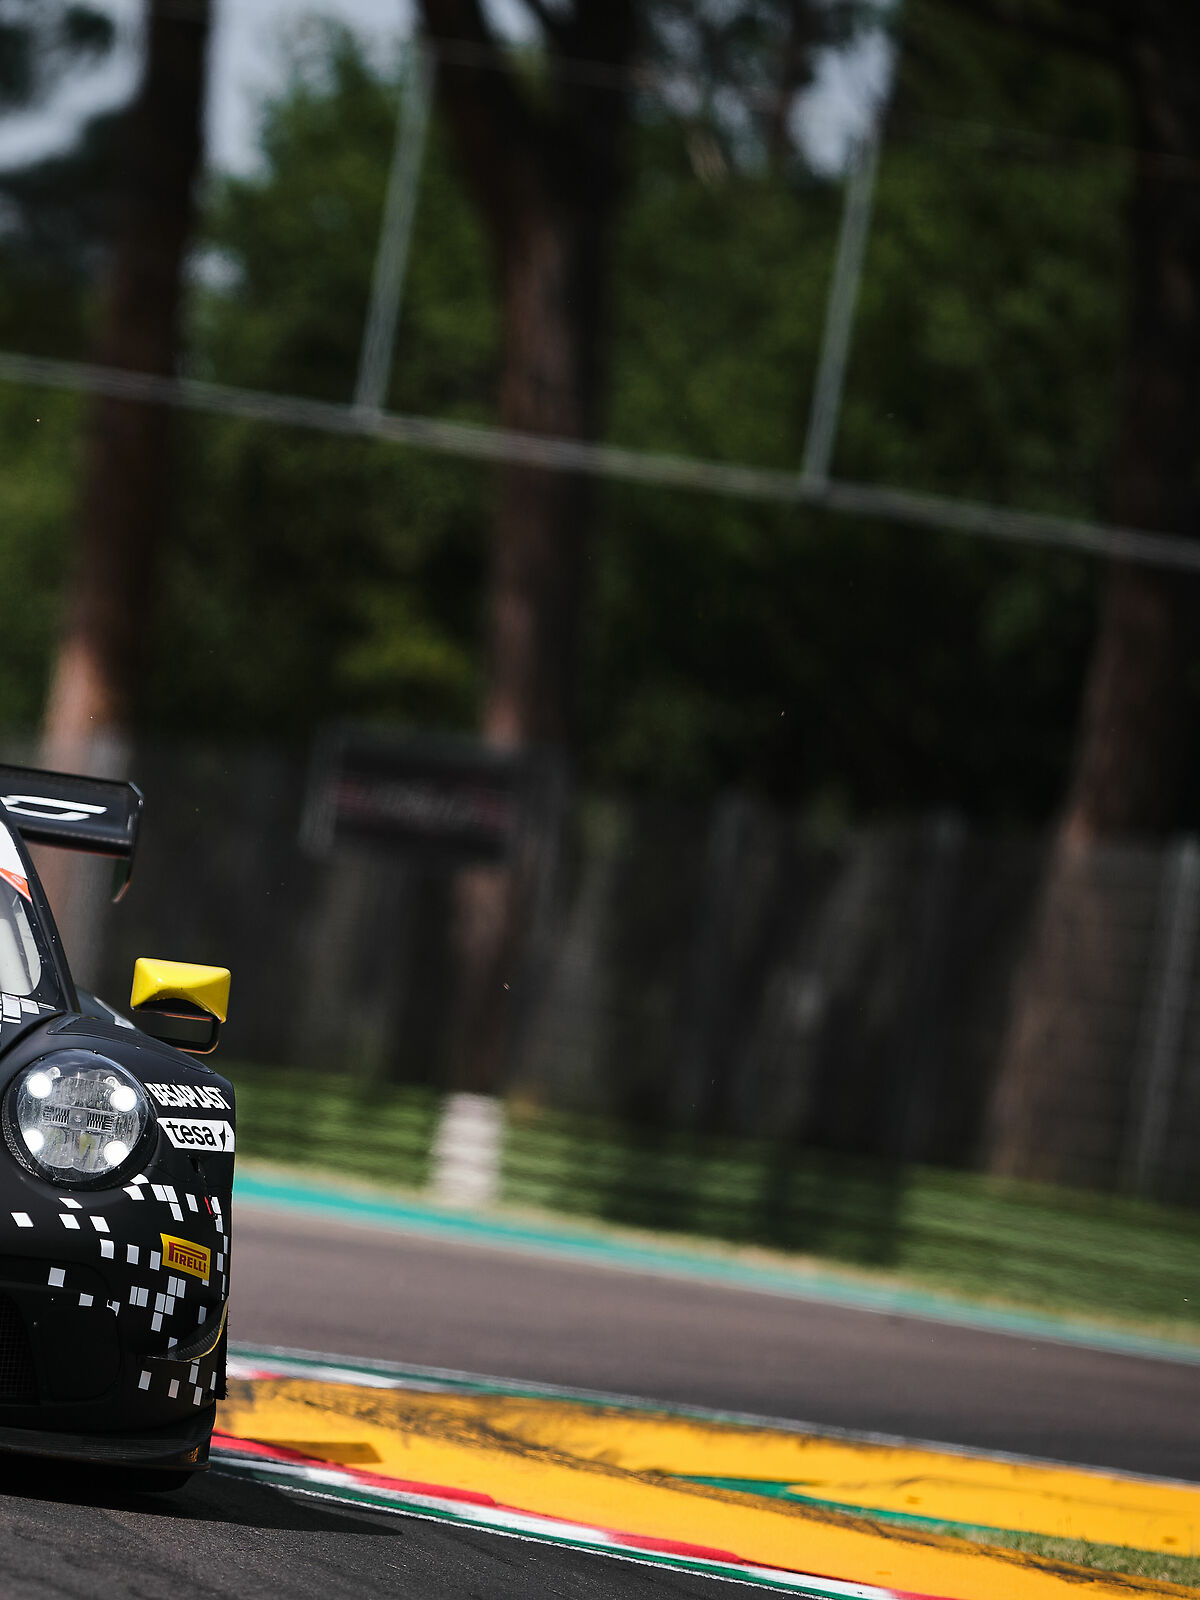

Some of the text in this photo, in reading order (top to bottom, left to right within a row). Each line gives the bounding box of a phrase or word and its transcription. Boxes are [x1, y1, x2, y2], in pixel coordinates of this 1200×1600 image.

[143, 1082, 231, 1110] BESAPLAST
[165, 1120, 218, 1147] tesa
[168, 1241, 208, 1274] PIRELLI
